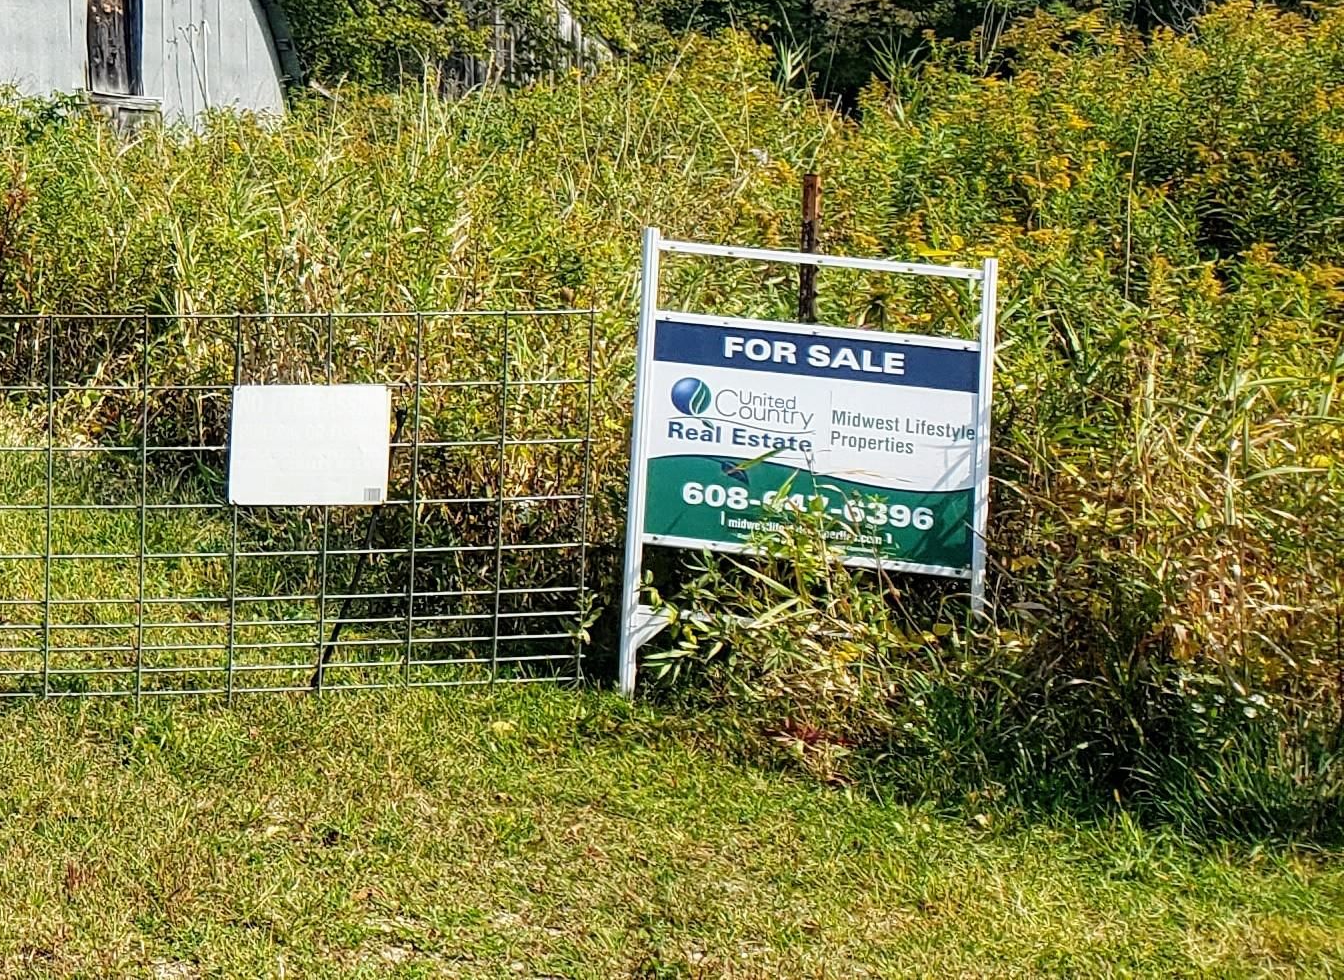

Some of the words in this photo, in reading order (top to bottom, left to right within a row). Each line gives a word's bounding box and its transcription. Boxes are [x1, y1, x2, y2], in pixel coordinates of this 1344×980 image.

[723, 336, 797, 365] FOR
[807, 345, 905, 375] SALE
[715, 389, 814, 430] Country
[739, 390, 797, 410] United
[667, 421, 722, 443] Real
[732, 427, 813, 453] Estate
[831, 409, 899, 432] Midwest
[905, 417, 976, 442] Lifestyle
[830, 430, 914, 455] Properties
